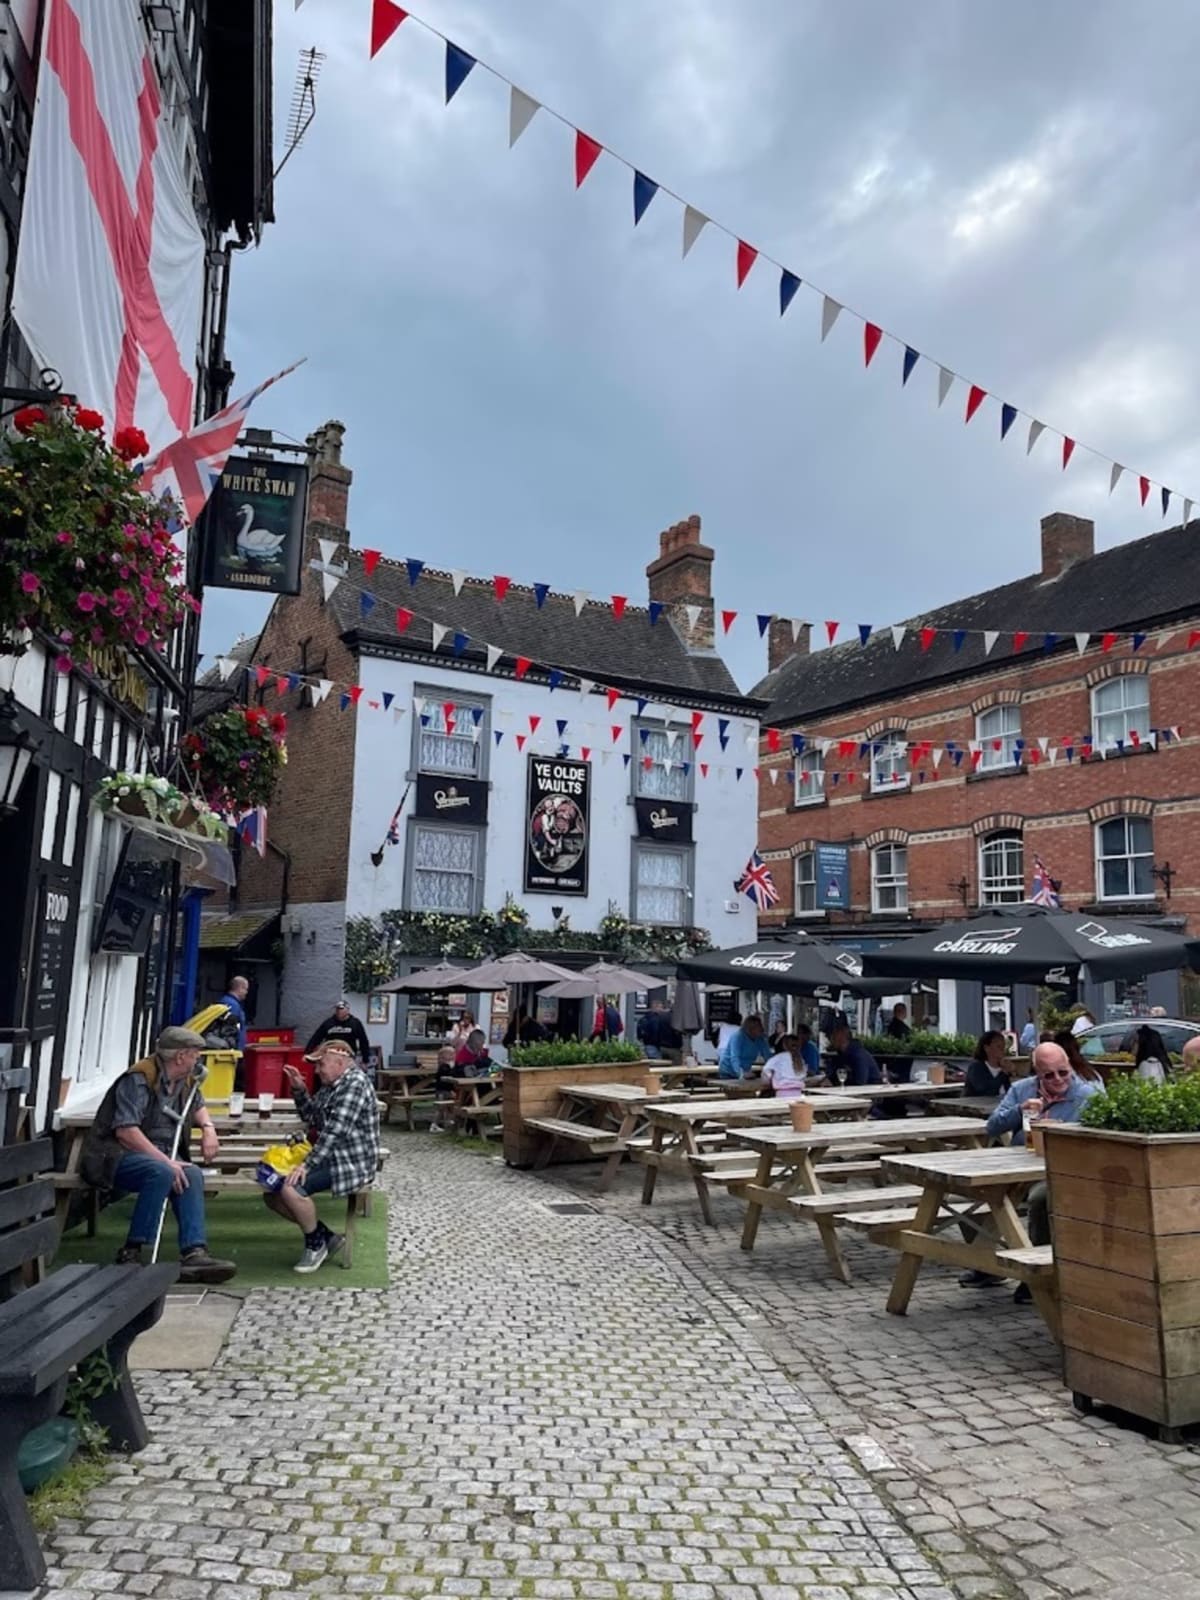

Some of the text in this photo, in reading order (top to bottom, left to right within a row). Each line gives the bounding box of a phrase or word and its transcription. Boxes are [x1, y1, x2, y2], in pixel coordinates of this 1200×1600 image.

[252, 467, 267, 478] THE
[222, 474, 296, 497] WHITE SWAN
[534, 763, 586, 781] YE OLDE
[537, 778, 582, 795] VAULTS
[45, 892, 69, 922] FOOD
[933, 940, 1020, 954] CARLING
[730, 957, 793, 972] CARLING
